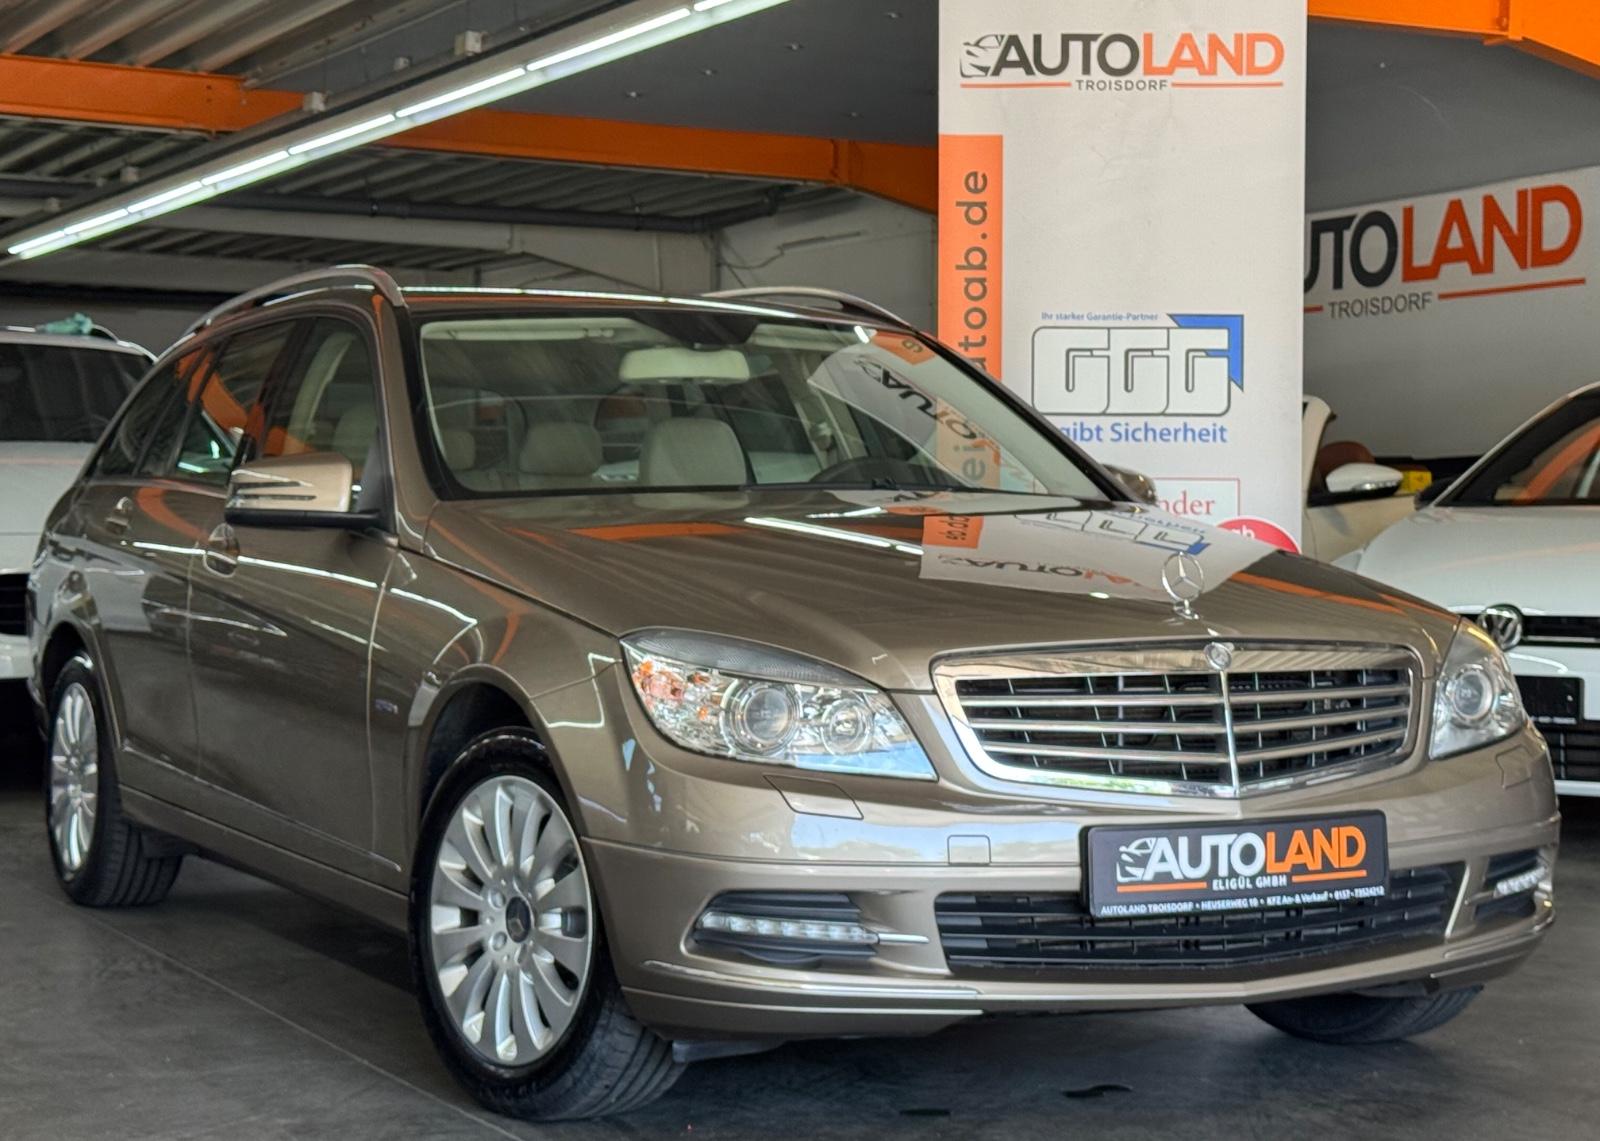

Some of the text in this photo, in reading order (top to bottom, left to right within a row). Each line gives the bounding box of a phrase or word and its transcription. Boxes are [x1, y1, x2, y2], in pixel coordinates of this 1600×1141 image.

[989, 33, 1285, 77] AUTOLAND
[1076, 80, 1169, 91] TROISDORF
[1328, 291, 1433, 319] TROISDORF
[1041, 312, 1158, 321] Ihr starker Garantie-Partner
[1110, 421, 1229, 443] Sicherheit
[1142, 825, 1367, 881] AUTOLAND
[1212, 876, 1253, 891] ELIGÜL
[1101, 904, 1147, 915] AUTOLAND
[1148, 902, 1193, 913] TROISDORF
